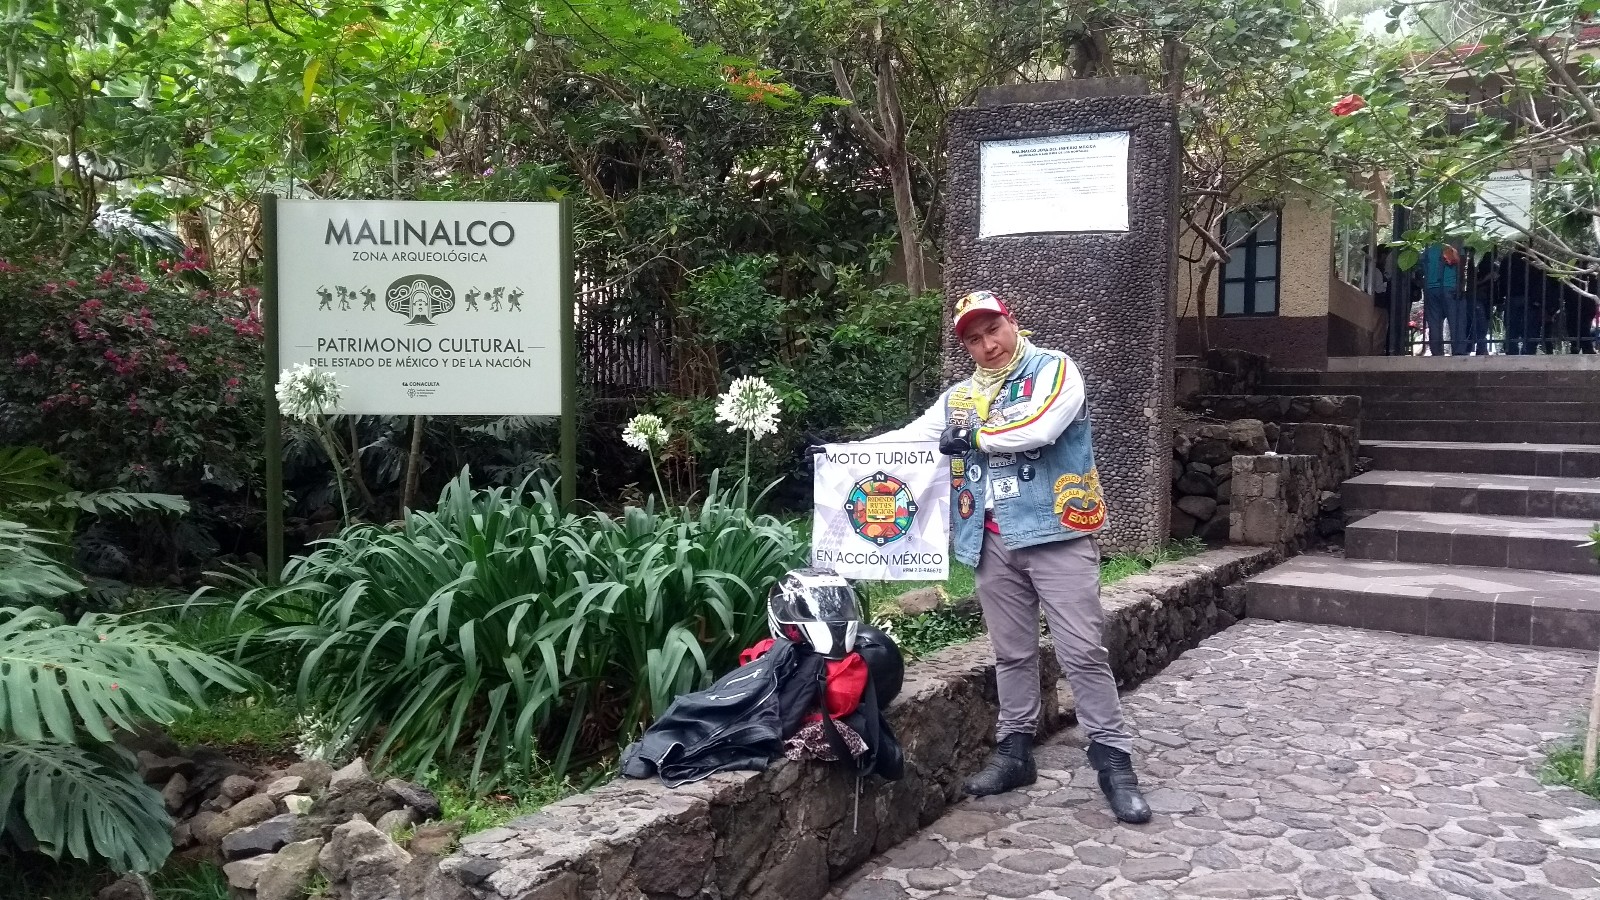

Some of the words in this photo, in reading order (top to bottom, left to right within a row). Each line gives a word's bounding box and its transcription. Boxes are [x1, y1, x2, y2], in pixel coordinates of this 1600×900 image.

[324, 218, 515, 246] MALINALCO
[352, 251, 388, 262] ZONA
[391, 249, 488, 263] ARQUEOLÓGICA
[317, 337, 432, 353] PATRIMONIO
[438, 338, 525, 353] CULTURAL
[309, 357, 328, 367] DEL
[331, 357, 374, 368] ESTADO
[378, 358, 392, 368] DE
[395, 355, 439, 368] MÉXICO
[442, 358, 449, 368] Y
[452, 358, 465, 368] DE
[469, 358, 483, 368] LA
[486, 356, 531, 368] NACIÓN
[826, 452, 871, 465] MOTO
[876, 451, 935, 465] TURISTA
[1054, 475, 1081, 492] MORELOS
[1056, 490, 1080, 508] TLAXCALA
[1068, 511, 1088, 525] EDO
[816, 550, 833, 561] EN
[836, 551, 889, 565] ACCIÓN
[892, 551, 943, 565] MÉXICO
